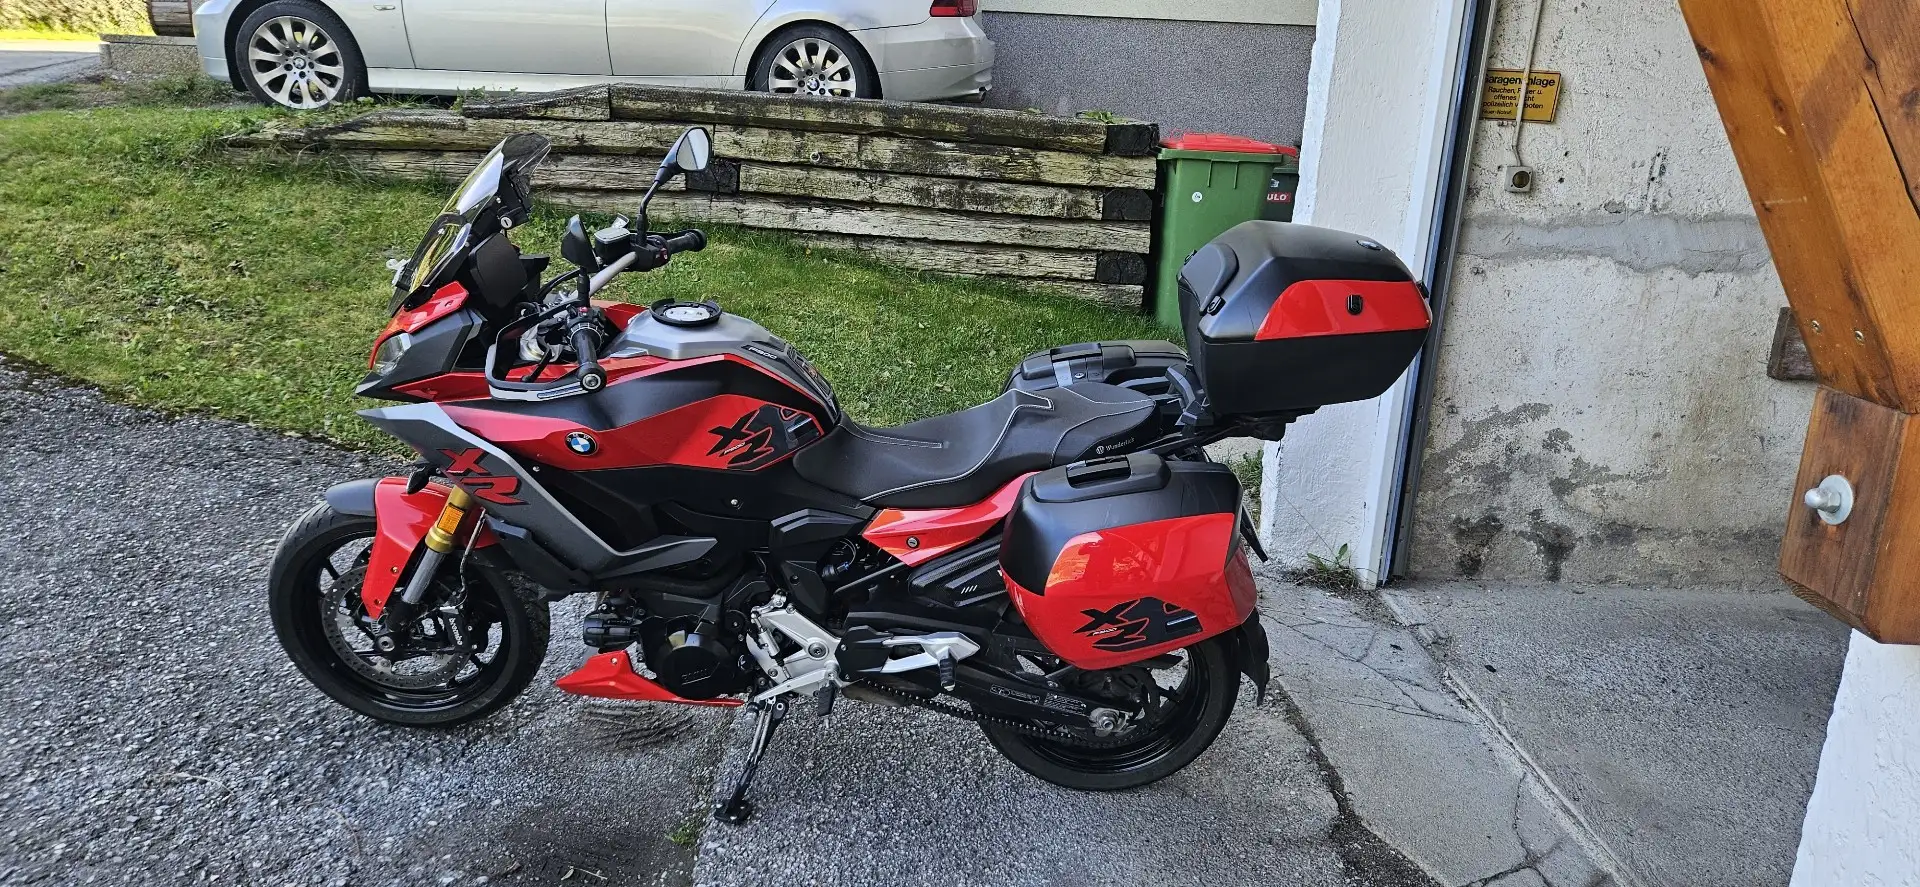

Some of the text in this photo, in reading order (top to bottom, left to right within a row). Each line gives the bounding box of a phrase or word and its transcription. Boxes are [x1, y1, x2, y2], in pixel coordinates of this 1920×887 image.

[1485, 75, 1556, 87] aragennlage
[1488, 86, 1516, 94] Rauchen,
[1516, 87, 1537, 95] Fer
[1266, 193, 1287, 201] ULO
[436, 448, 531, 506] XR
[449, 617, 463, 646] brembo
